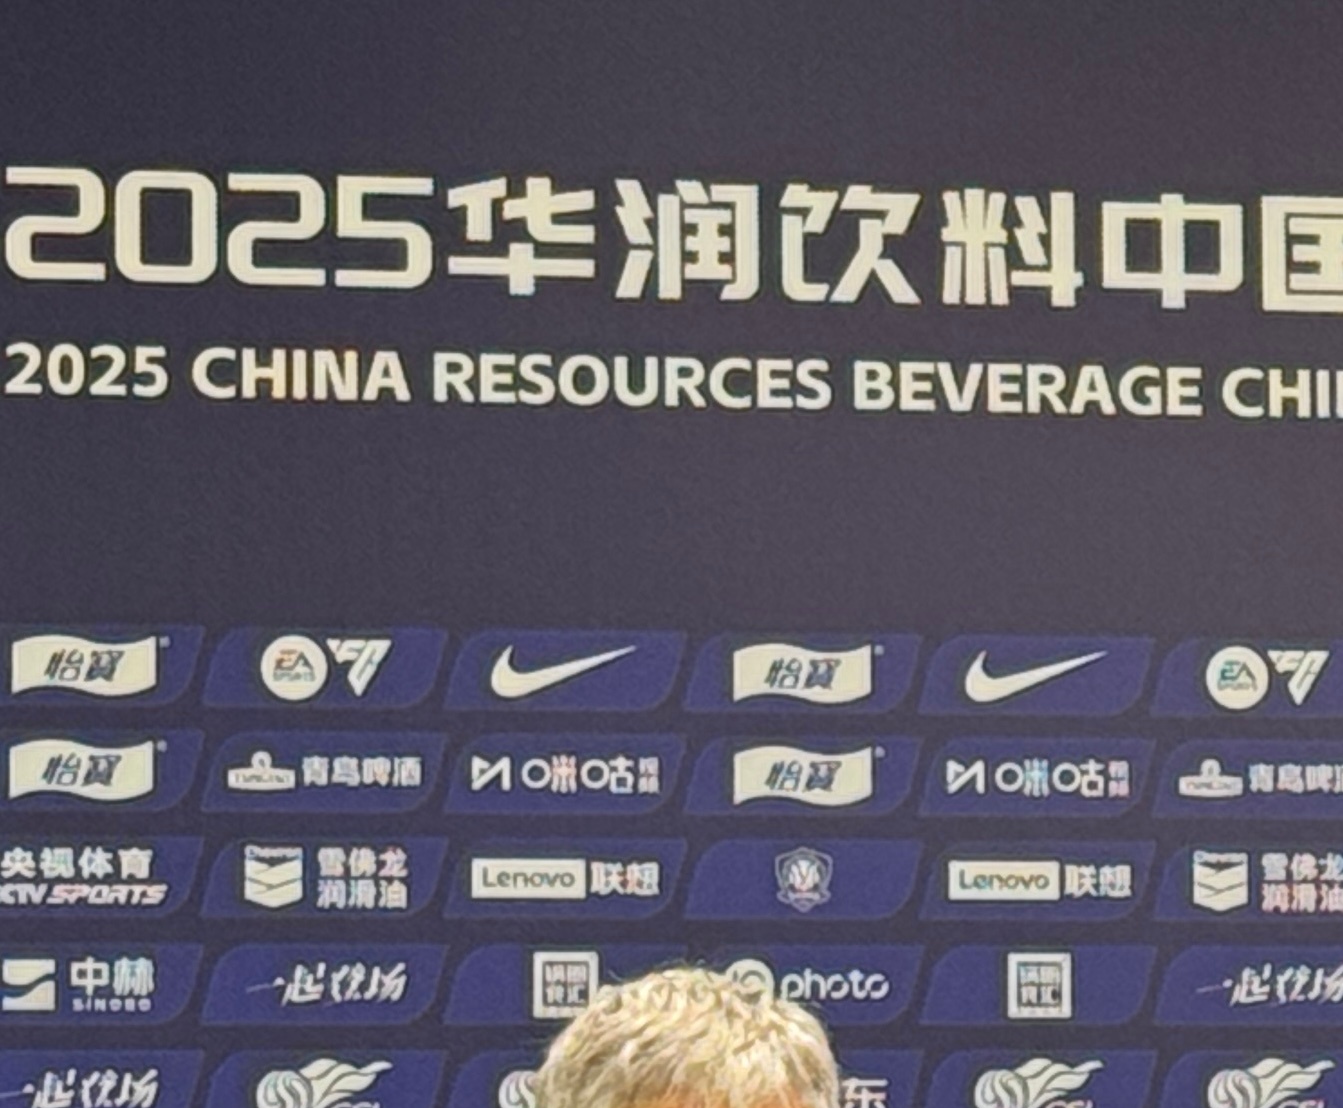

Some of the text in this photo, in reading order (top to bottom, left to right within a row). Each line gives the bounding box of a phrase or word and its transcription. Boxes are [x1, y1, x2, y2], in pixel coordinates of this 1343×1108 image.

[6, 342, 167, 396] 2025
[192, 347, 410, 401] CHINA
[434, 353, 831, 409] RESOURCES
[854, 361, 1202, 415] BEVERAGE
[480, 866, 577, 891] Lenovo
[957, 867, 1050, 892] Lenovo
